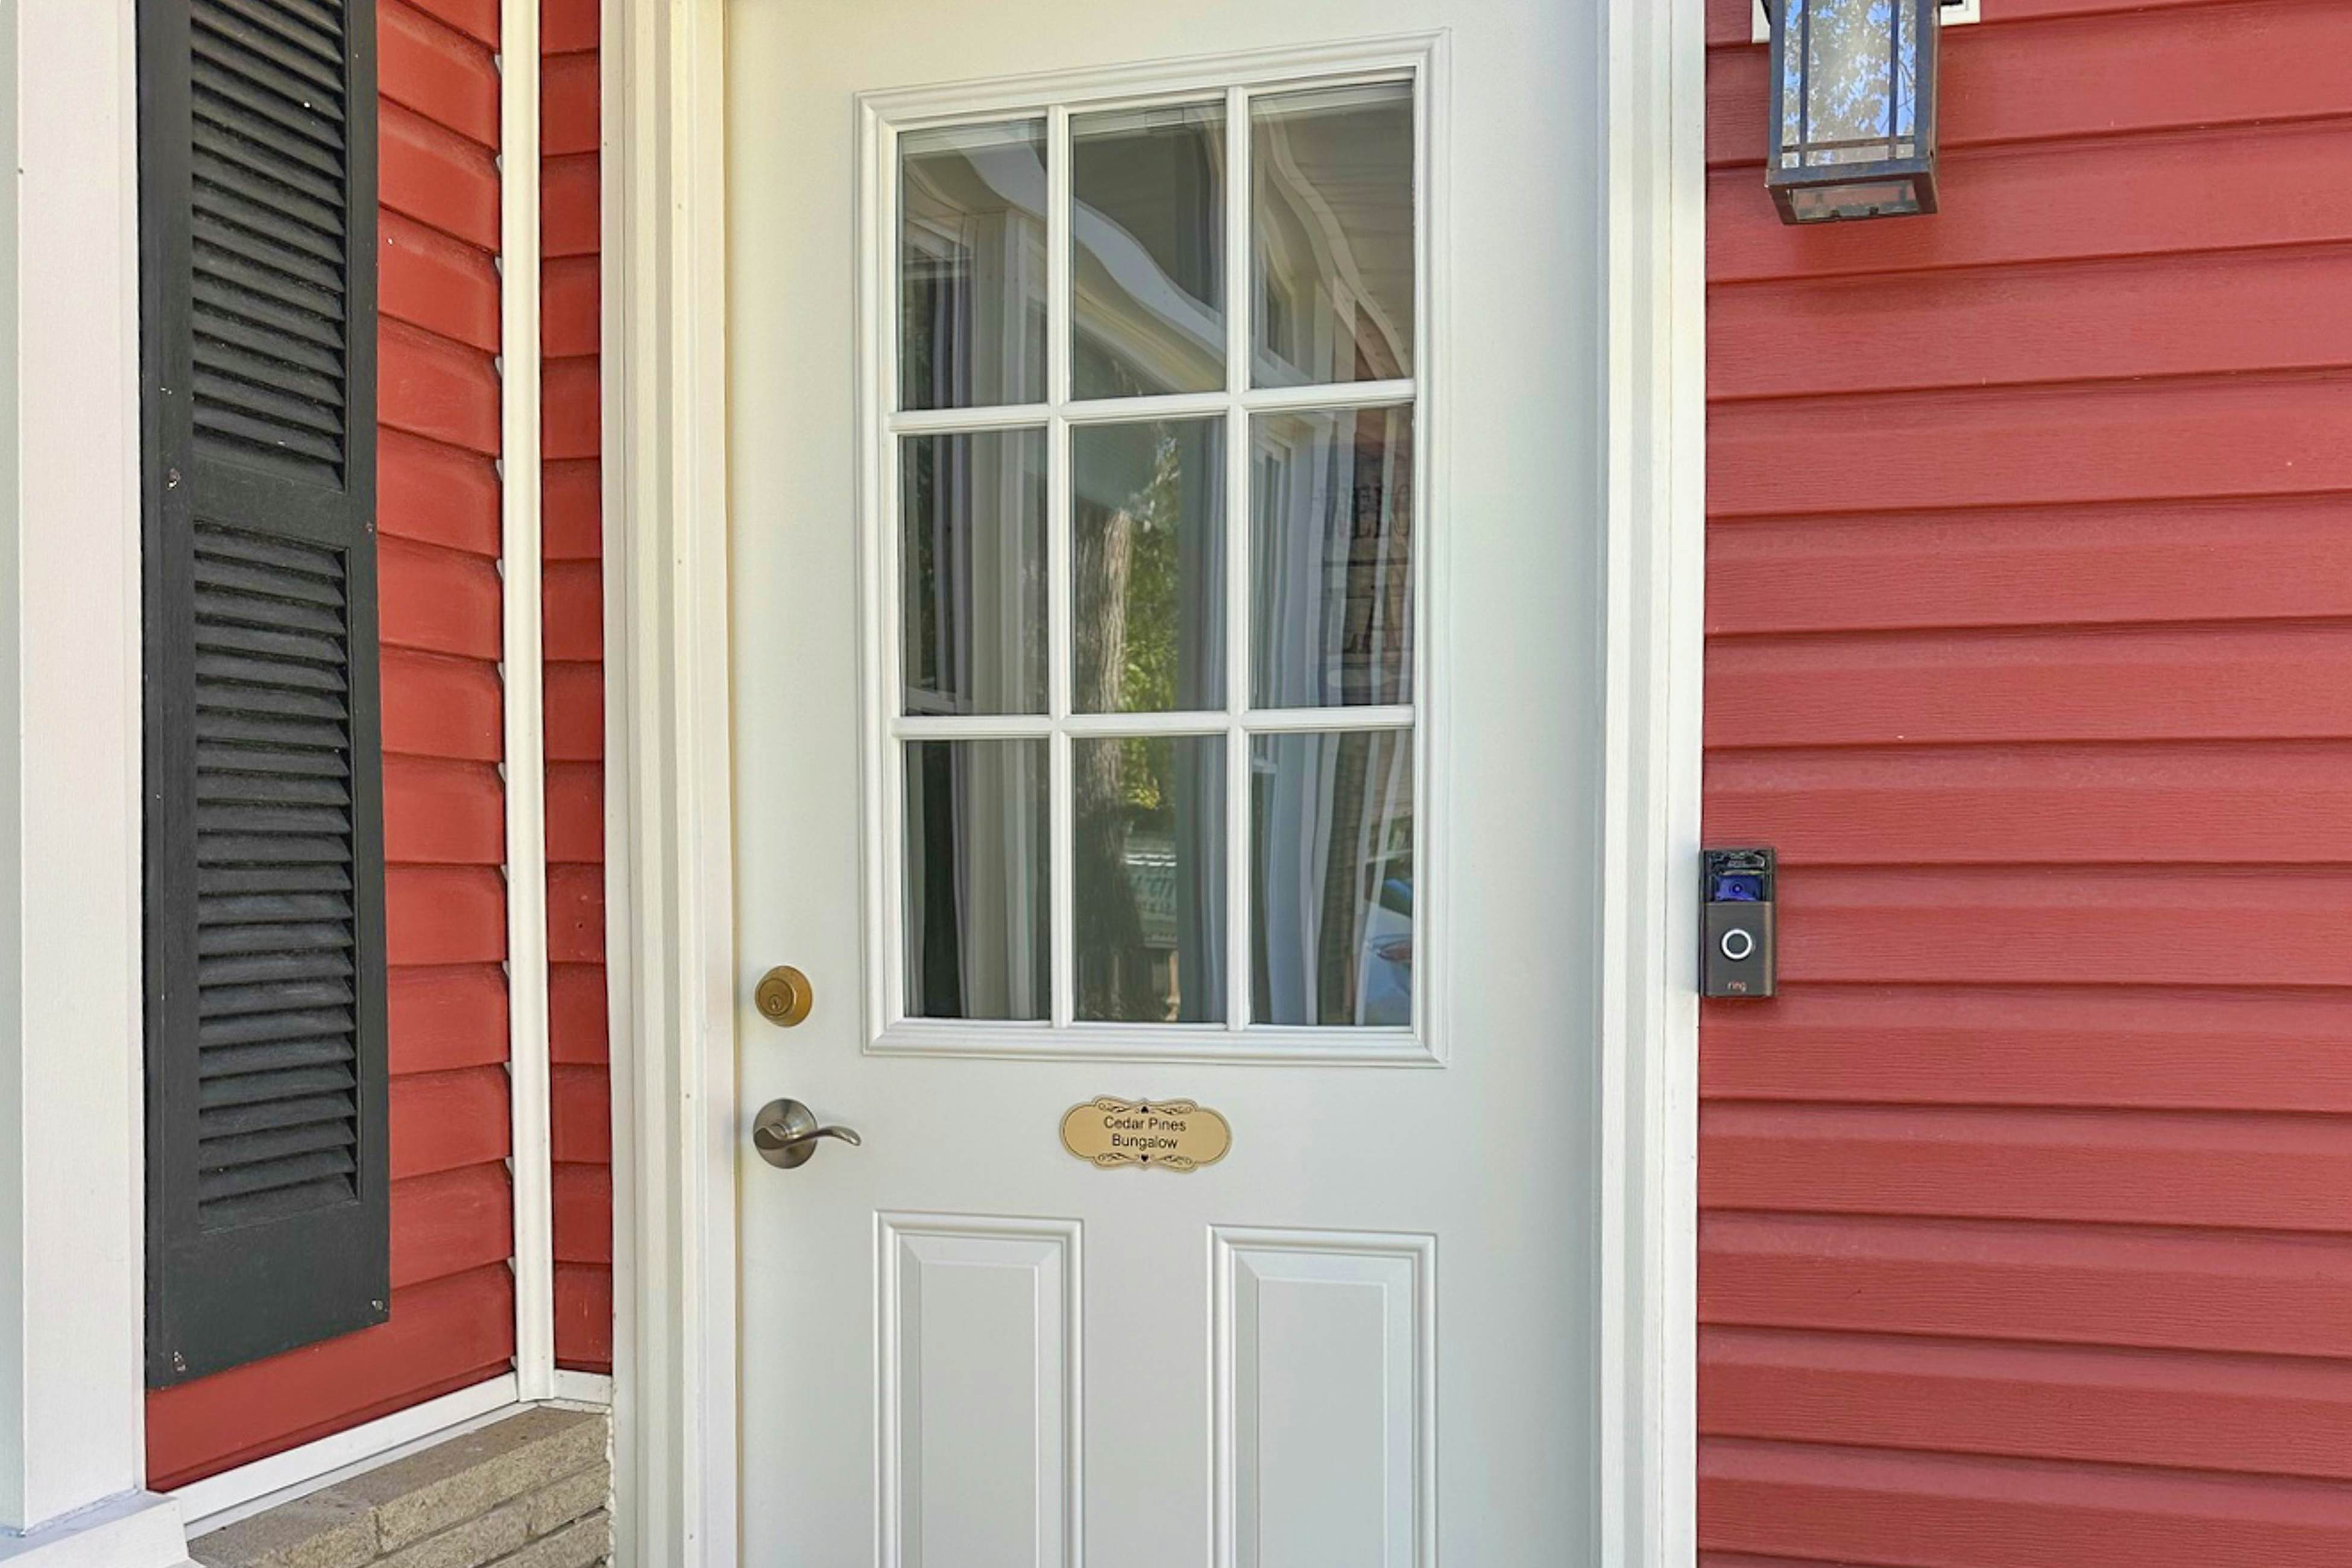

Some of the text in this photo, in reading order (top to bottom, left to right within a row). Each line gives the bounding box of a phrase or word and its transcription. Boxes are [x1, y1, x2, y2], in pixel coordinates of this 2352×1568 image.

[1727, 980, 1747, 992] ring
[1103, 1116, 1187, 1132] Cedar Pines
[1112, 1133, 1178, 1150] Bungalow
